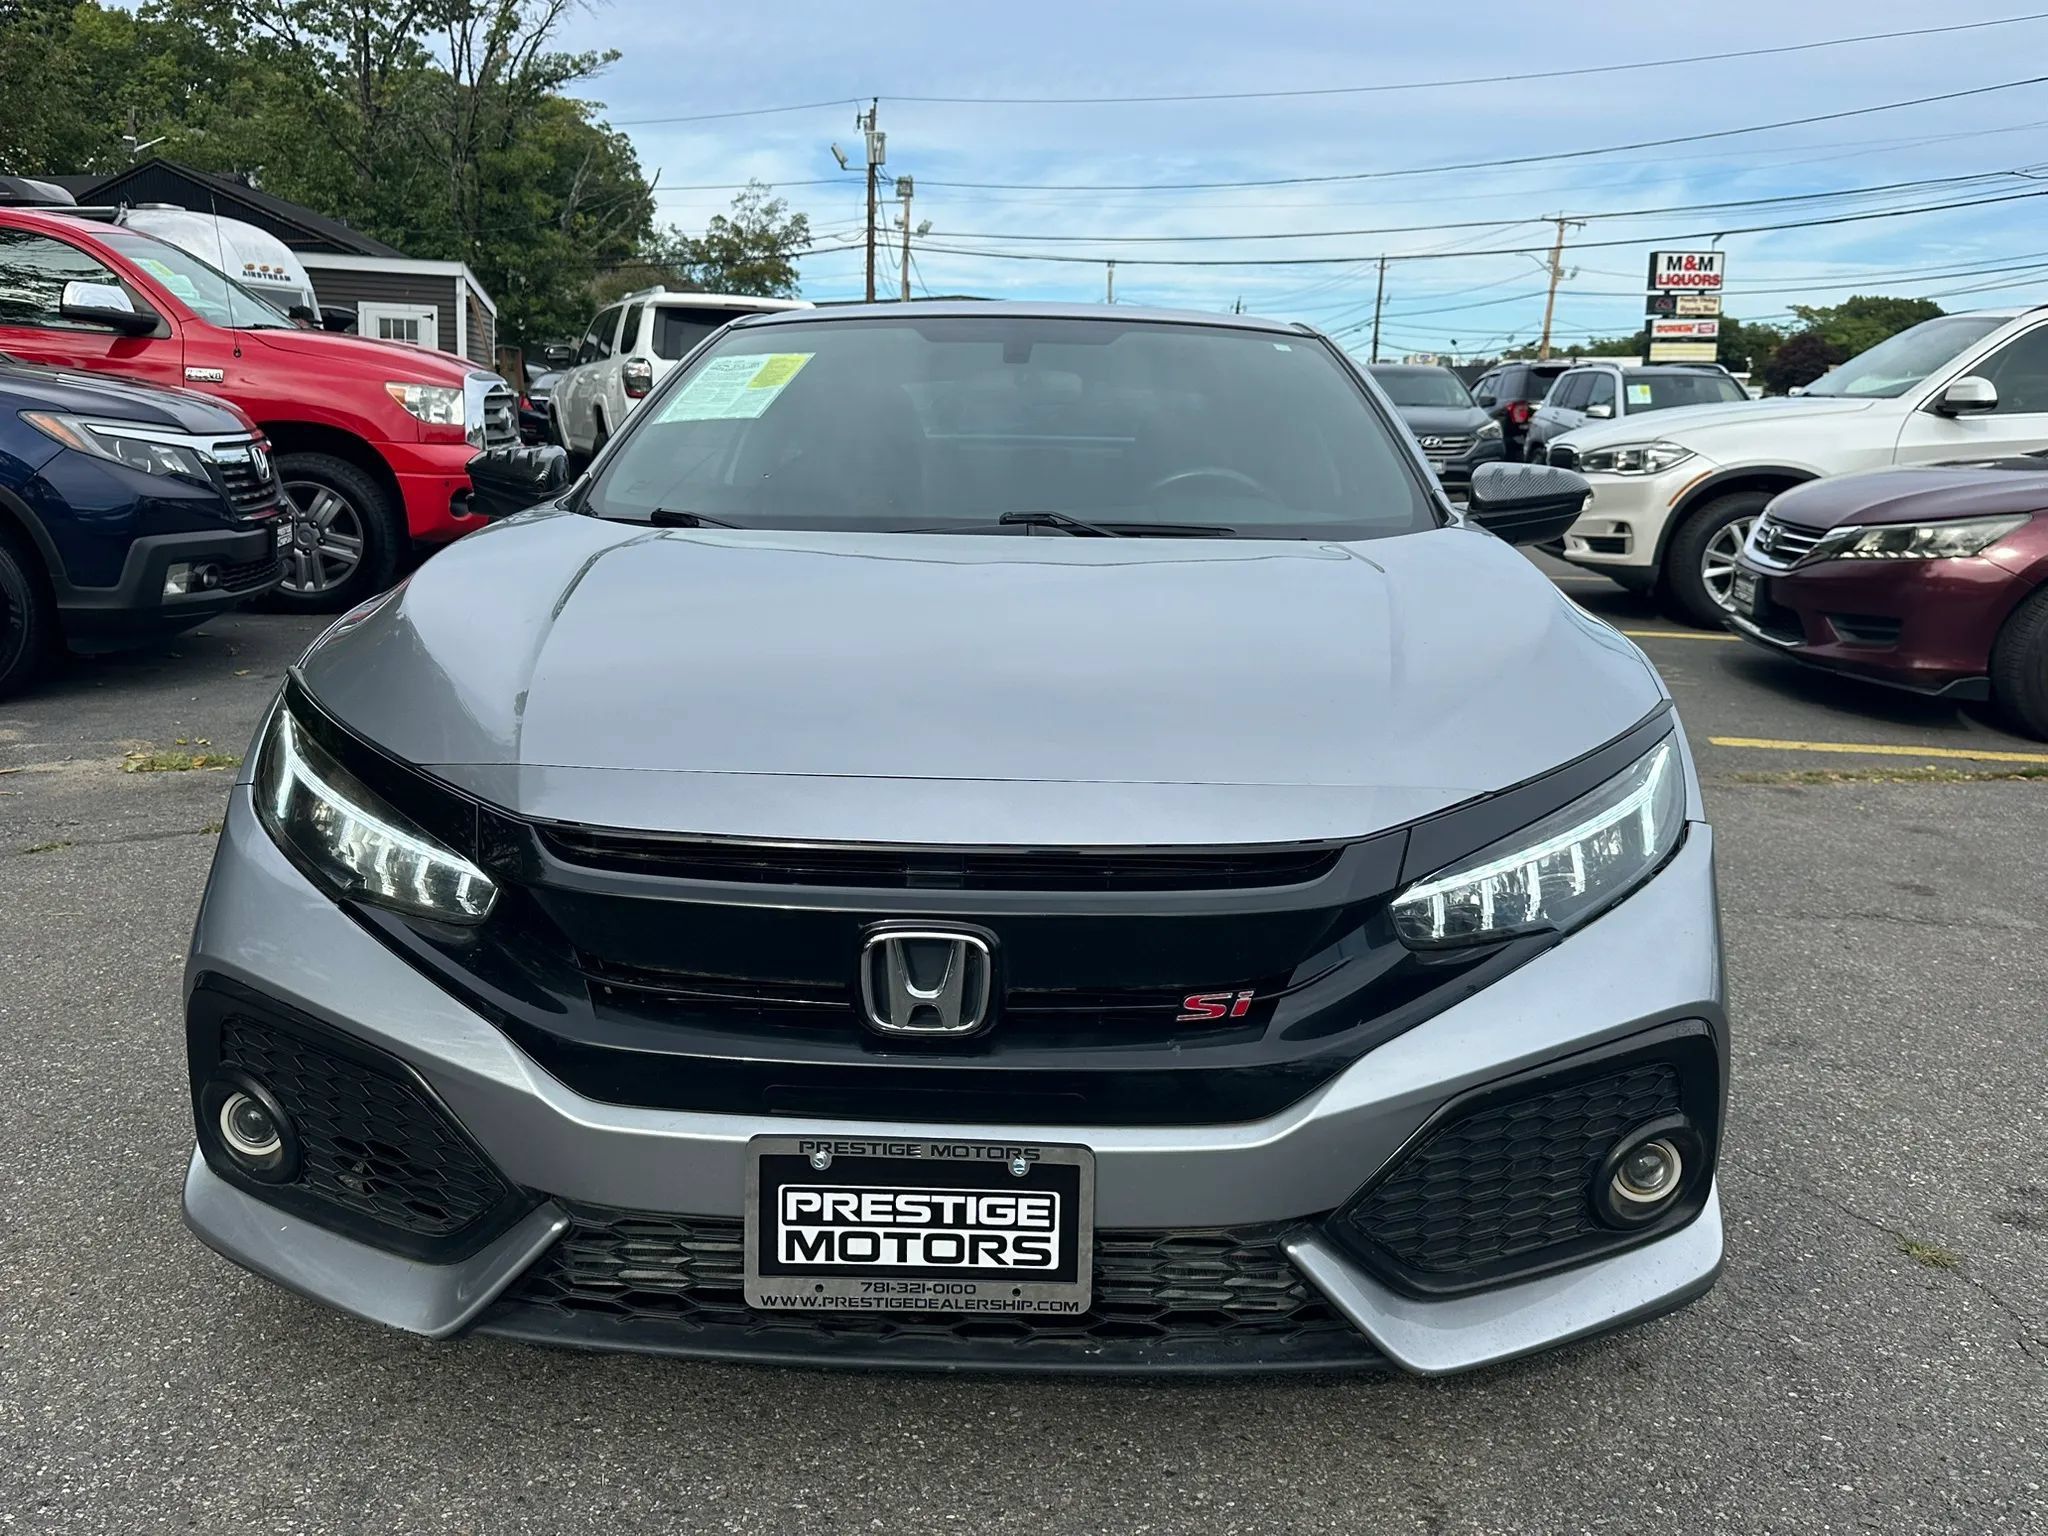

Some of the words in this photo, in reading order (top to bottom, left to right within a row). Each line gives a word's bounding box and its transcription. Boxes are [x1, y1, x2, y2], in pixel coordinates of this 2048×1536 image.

[1667, 255, 1714, 271] M&M
[242, 270, 291, 281] AIRSTREAM
[1658, 274, 1720, 286] LIQUORS
[1176, 990, 1254, 1021] Si
[799, 1140, 922, 1158] PRESTIGE
[930, 1144, 1041, 1161] MOTORS
[786, 1191, 1051, 1228] PRESTIGE
[785, 1230, 1052, 1268] MOTORS
[860, 1281, 977, 1295] 781-321-0100
[760, 1295, 1079, 1313] WWW.PRESTIGEDEALERSHIP.COM
